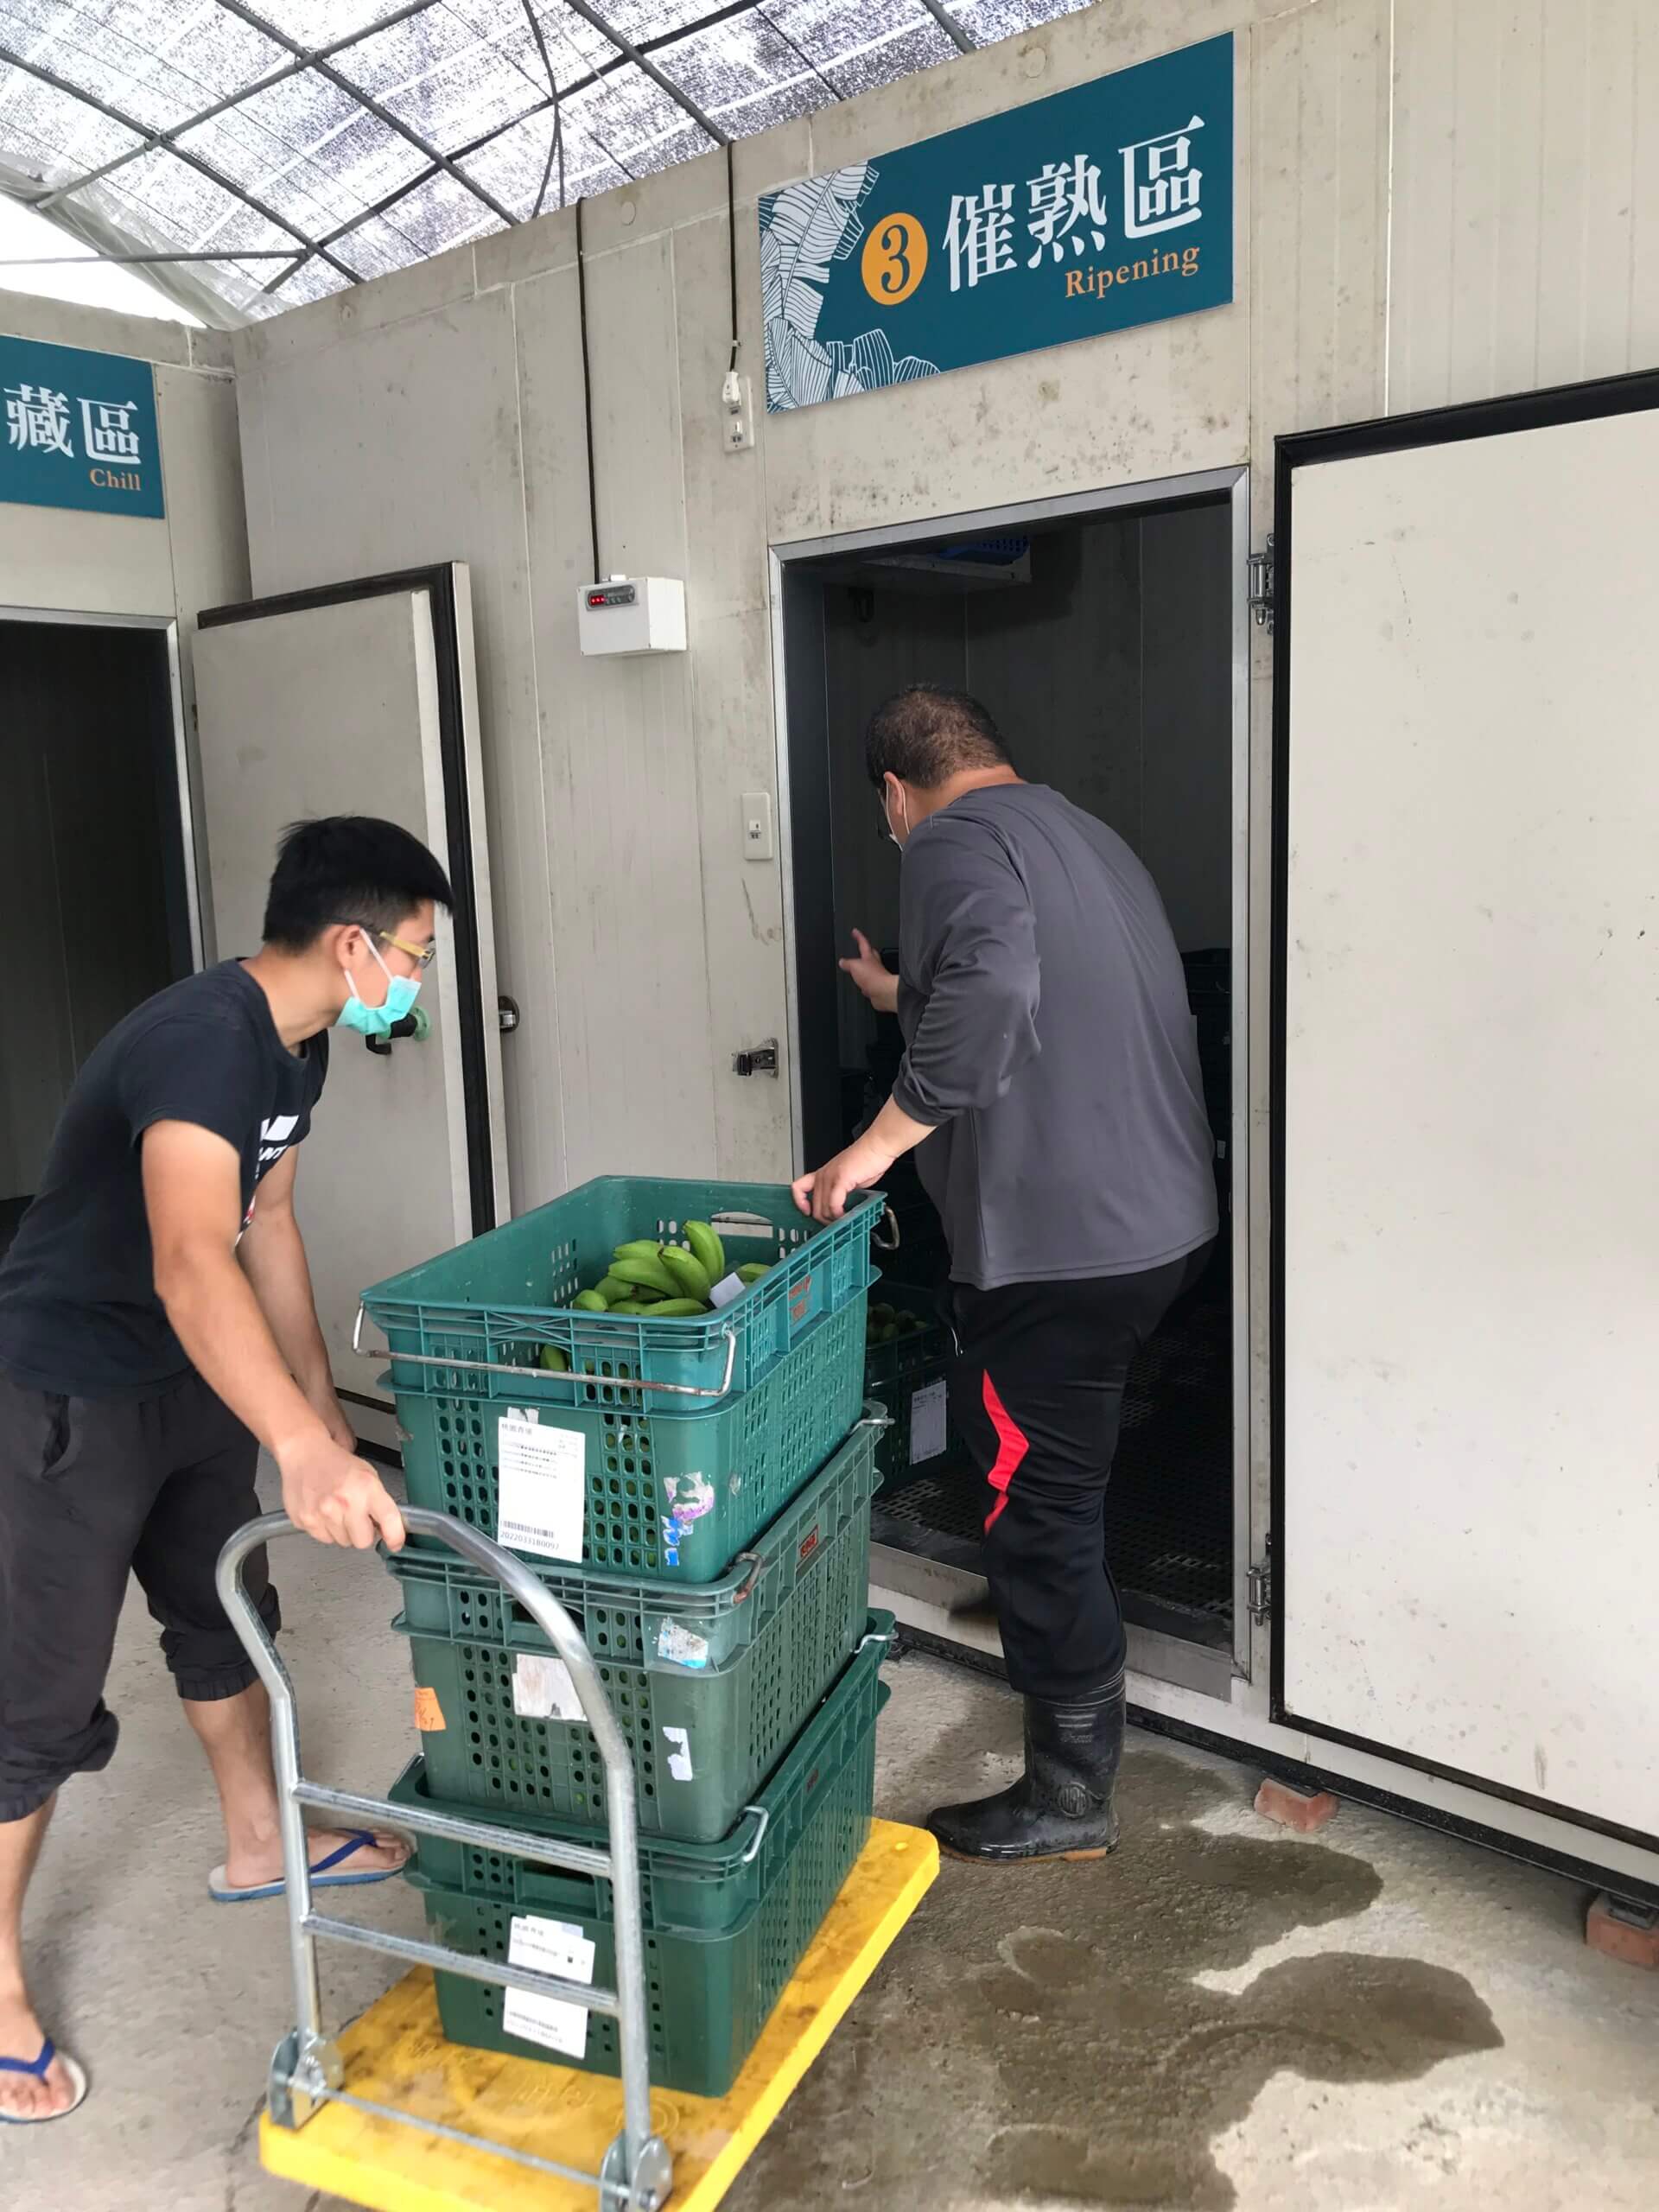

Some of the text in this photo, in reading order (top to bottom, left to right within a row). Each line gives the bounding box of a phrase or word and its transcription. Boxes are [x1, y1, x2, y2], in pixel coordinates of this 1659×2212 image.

[880, 114, 1206, 294] 3 催熟區
[1065, 245, 1201, 300] Ripening
[3, 383, 142, 465] 藏區
[89, 467, 142, 492] Chill
